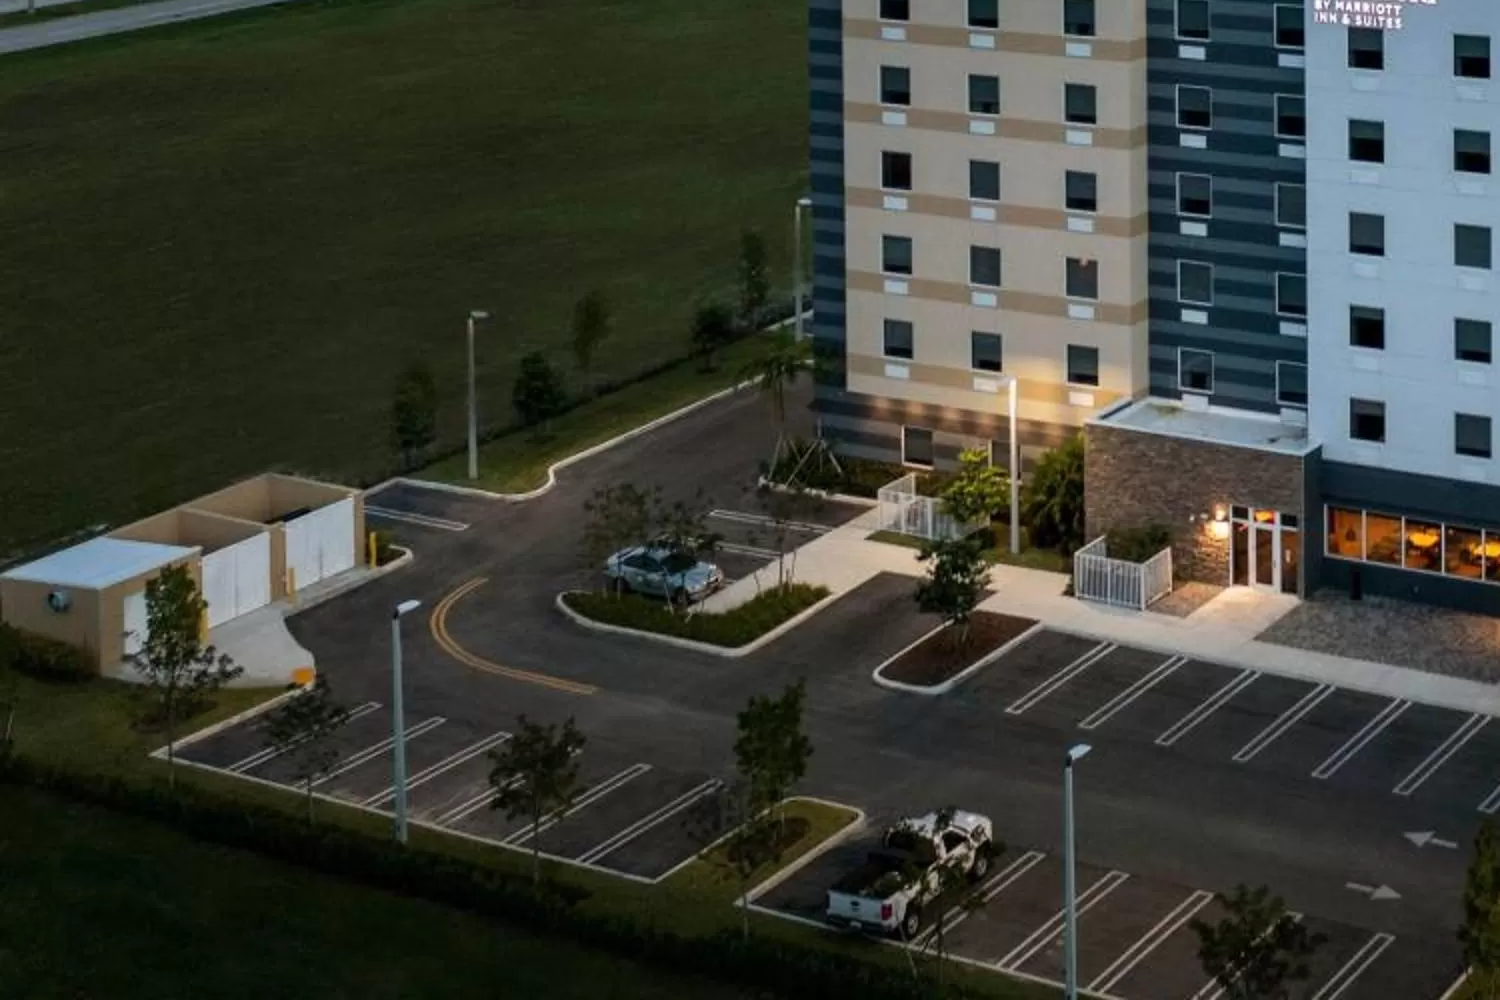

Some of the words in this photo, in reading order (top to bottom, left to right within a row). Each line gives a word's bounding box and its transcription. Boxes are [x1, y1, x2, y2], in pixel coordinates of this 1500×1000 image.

[1335, 0, 1402, 16] MARRIOTT
[1314, 12, 1337, 24] INN
[1341, 13, 1350, 25] &
[1355, 14, 1402, 29] SUITES
